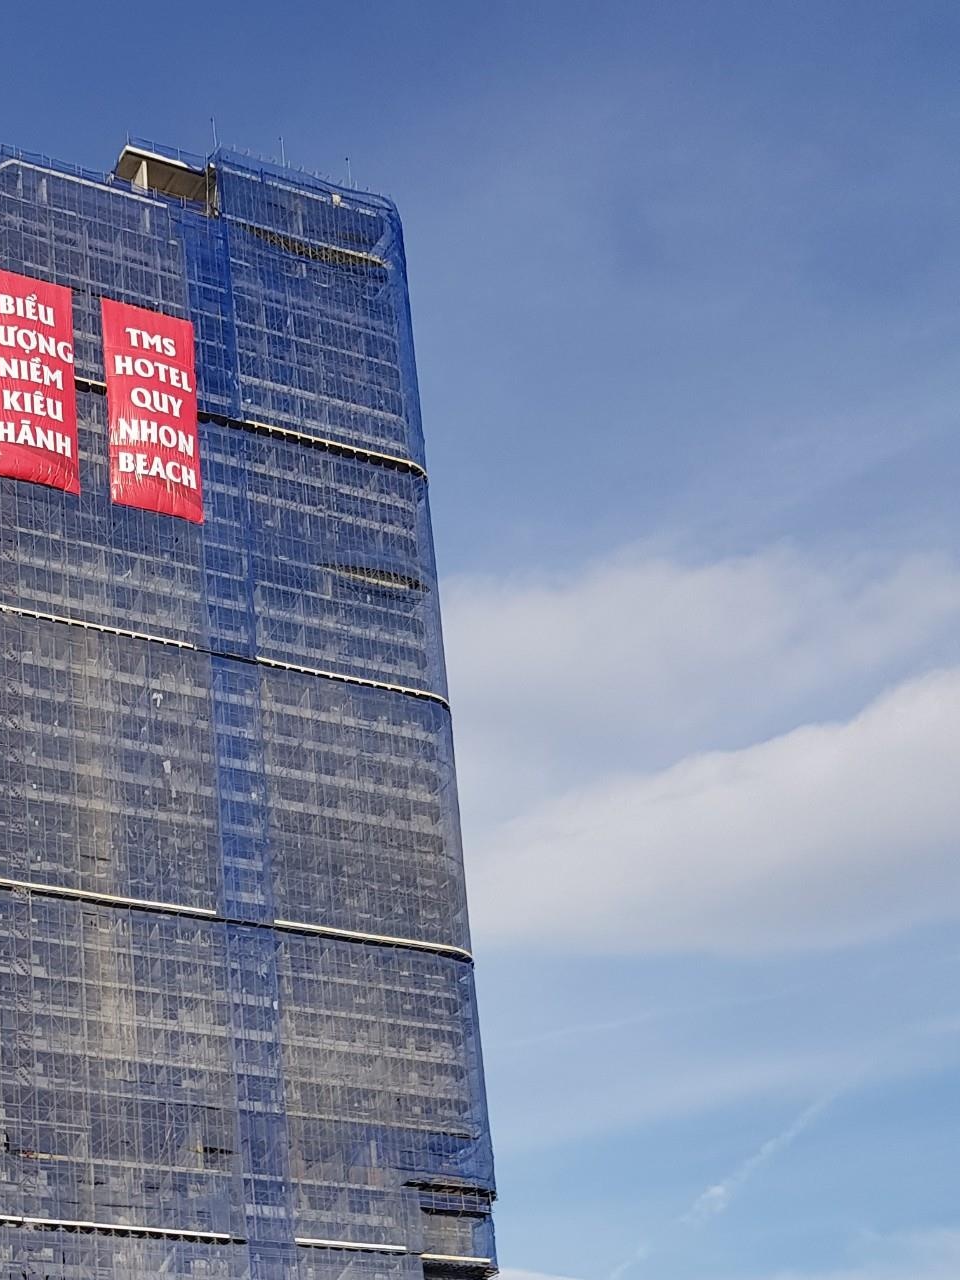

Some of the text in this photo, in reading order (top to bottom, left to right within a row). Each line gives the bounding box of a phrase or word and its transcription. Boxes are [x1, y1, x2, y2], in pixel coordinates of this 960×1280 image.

[125, 327, 176, 357] TMS
[114, 355, 193, 393] HOTEL
[2, 389, 63, 422] KIÊU
[130, 387, 183, 417] QUY
[118, 417, 194, 456] NHON
[118, 452, 197, 489] BEACH
